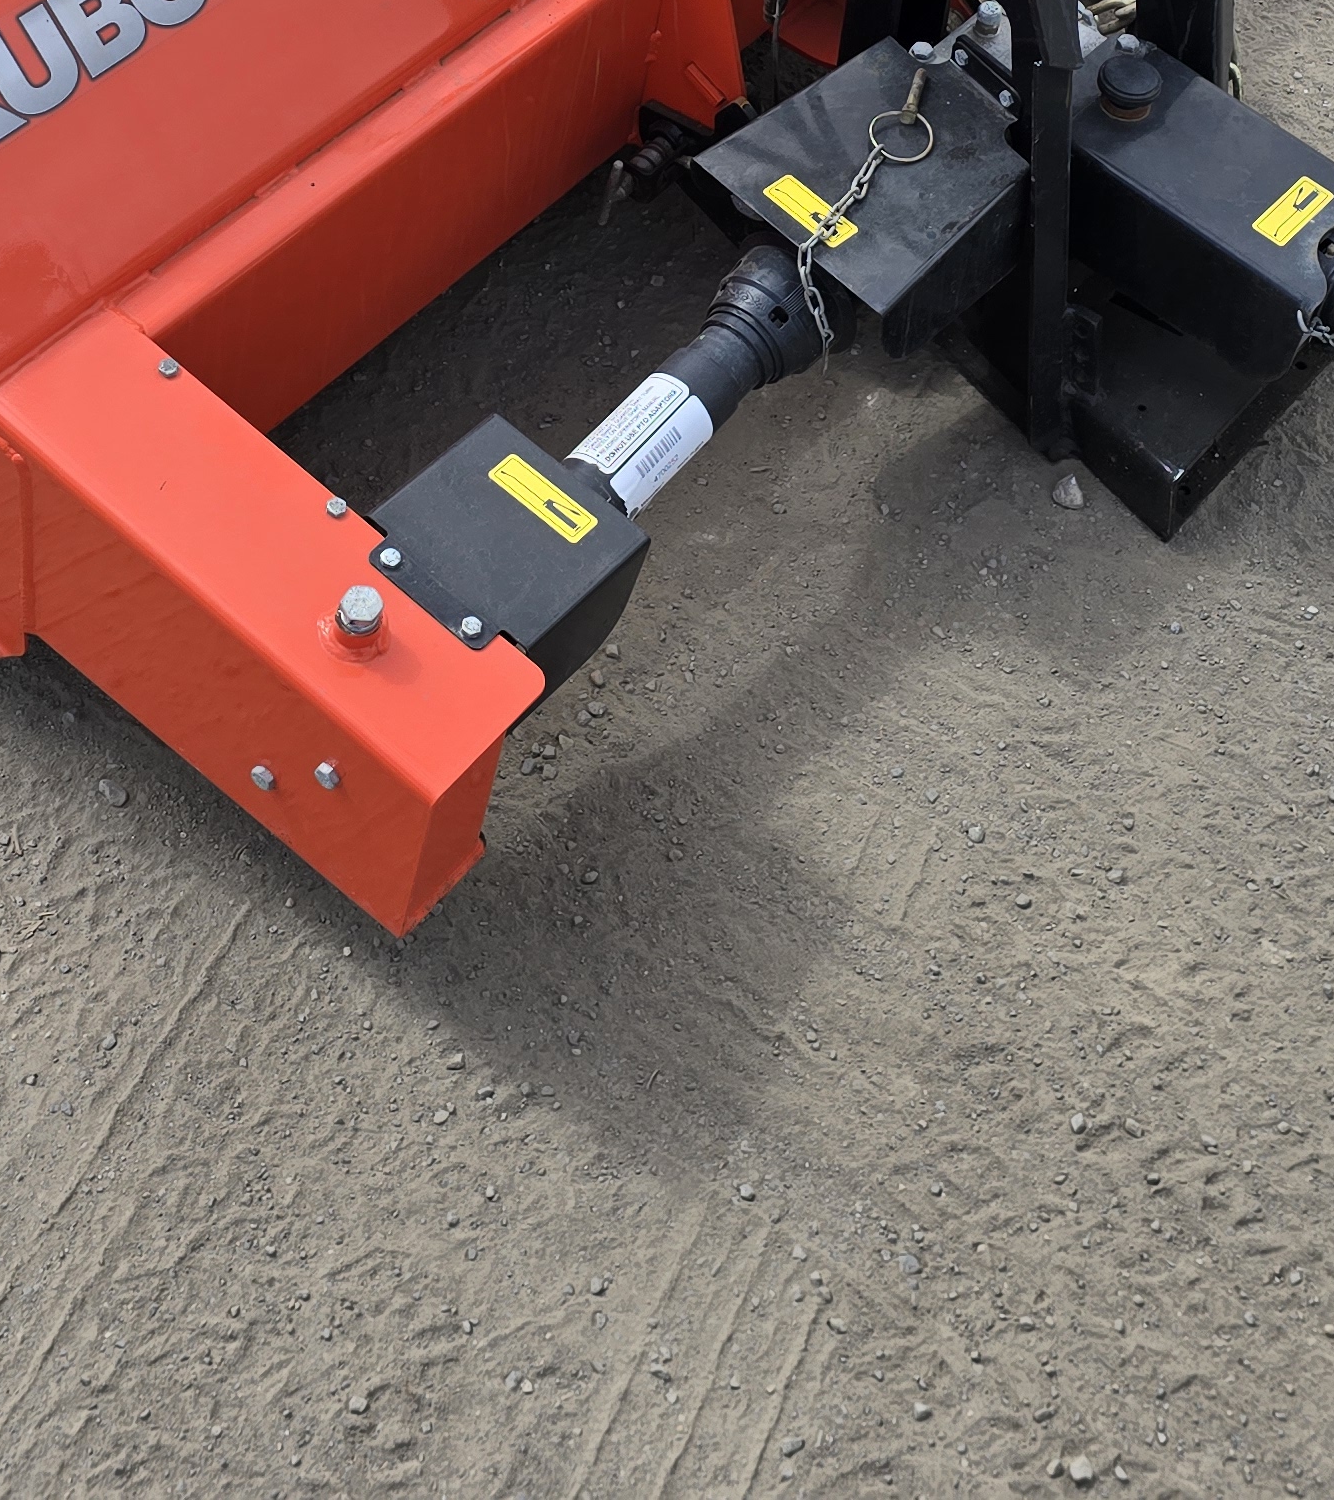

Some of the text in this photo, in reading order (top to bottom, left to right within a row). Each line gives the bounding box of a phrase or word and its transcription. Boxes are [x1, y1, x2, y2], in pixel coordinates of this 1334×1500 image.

[603, 388, 679, 461] DO NOT USE PTO ADAPTORS
